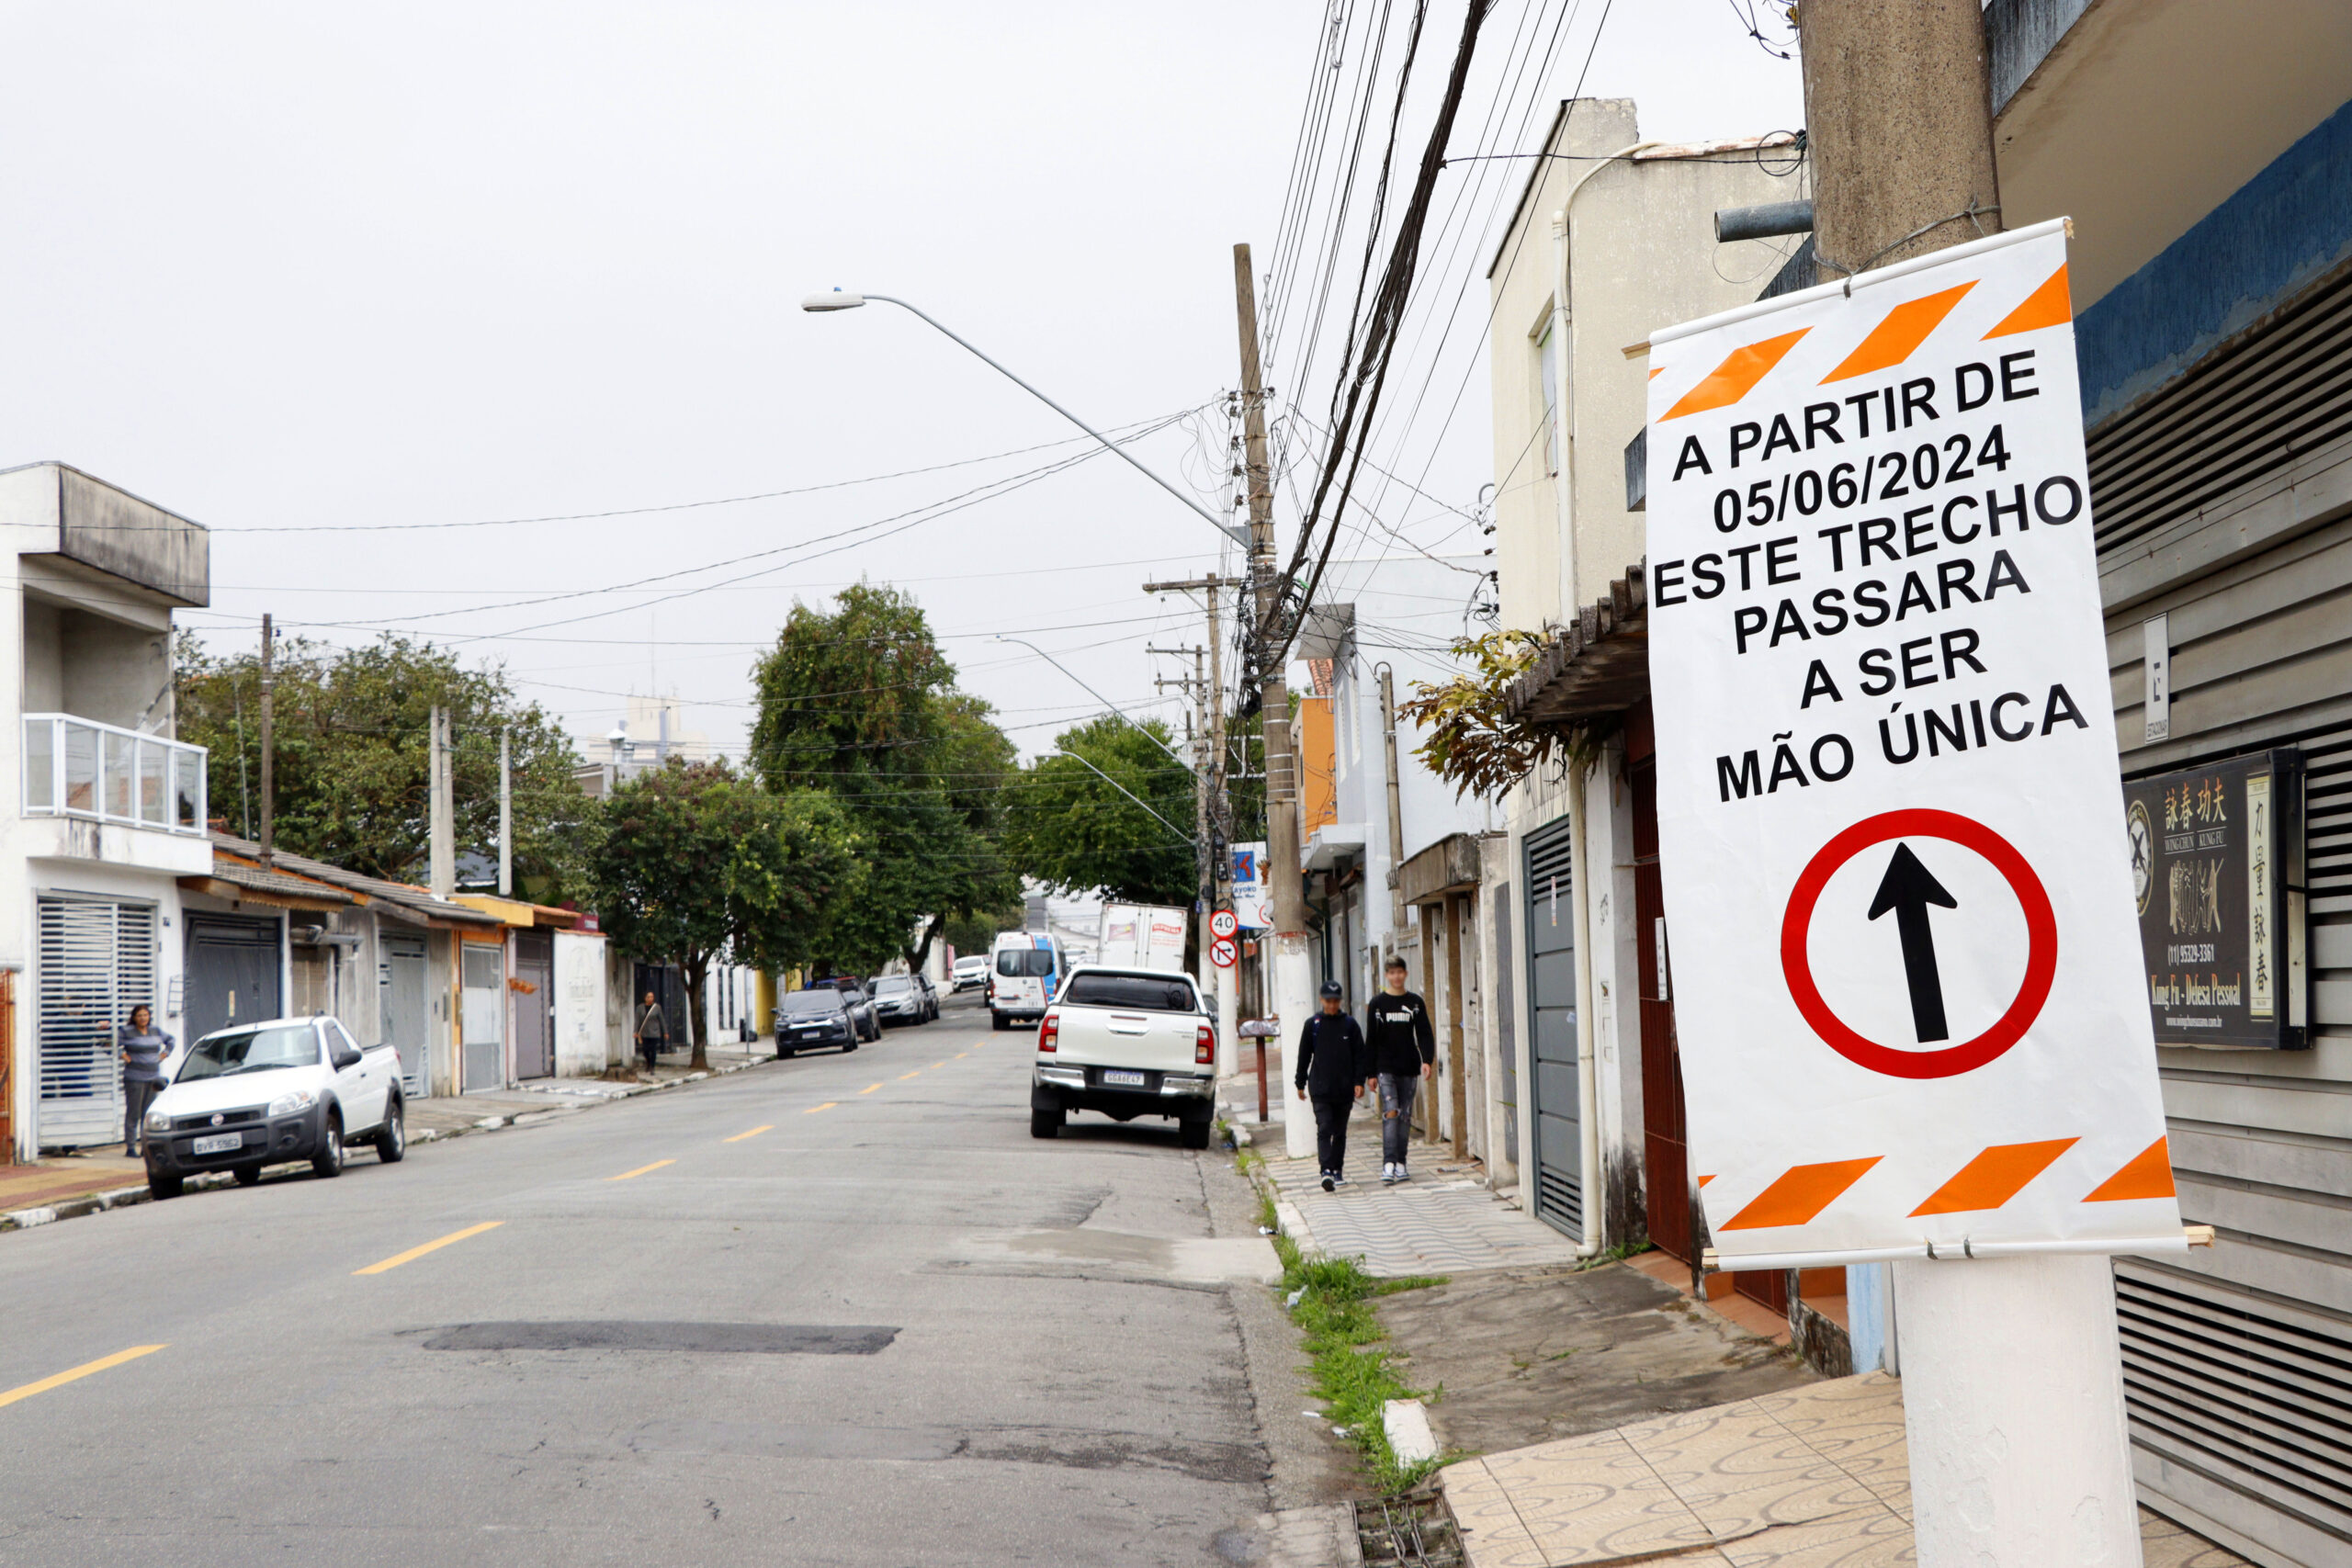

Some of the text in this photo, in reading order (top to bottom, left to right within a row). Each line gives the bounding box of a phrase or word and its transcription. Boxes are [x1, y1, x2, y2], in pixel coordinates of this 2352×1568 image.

[1673, 350, 2039, 481] A PARTIR DE
[1714, 424, 2010, 533] 05/06/2024
[1655, 476, 2082, 607] ESTE TRECHO
[1735, 550, 2030, 654] PASSARA
[1801, 628, 1987, 709] A SER
[1717, 684, 2088, 802] MÃO ÚNICA
[2199, 832, 2215, 847] KUNG
[2216, 830, 2223, 844] FU
[1215, 917, 1233, 929] 40
[2168, 944, 2179, 965] (11)
[1385, 1012, 1410, 1022] PUMA
[2151, 975, 2169, 1010] Kung
[2170, 974, 2179, 1005] Fu
[2186, 974, 2210, 1006] Defesa
[2211, 972, 2241, 1006] Pessoal
